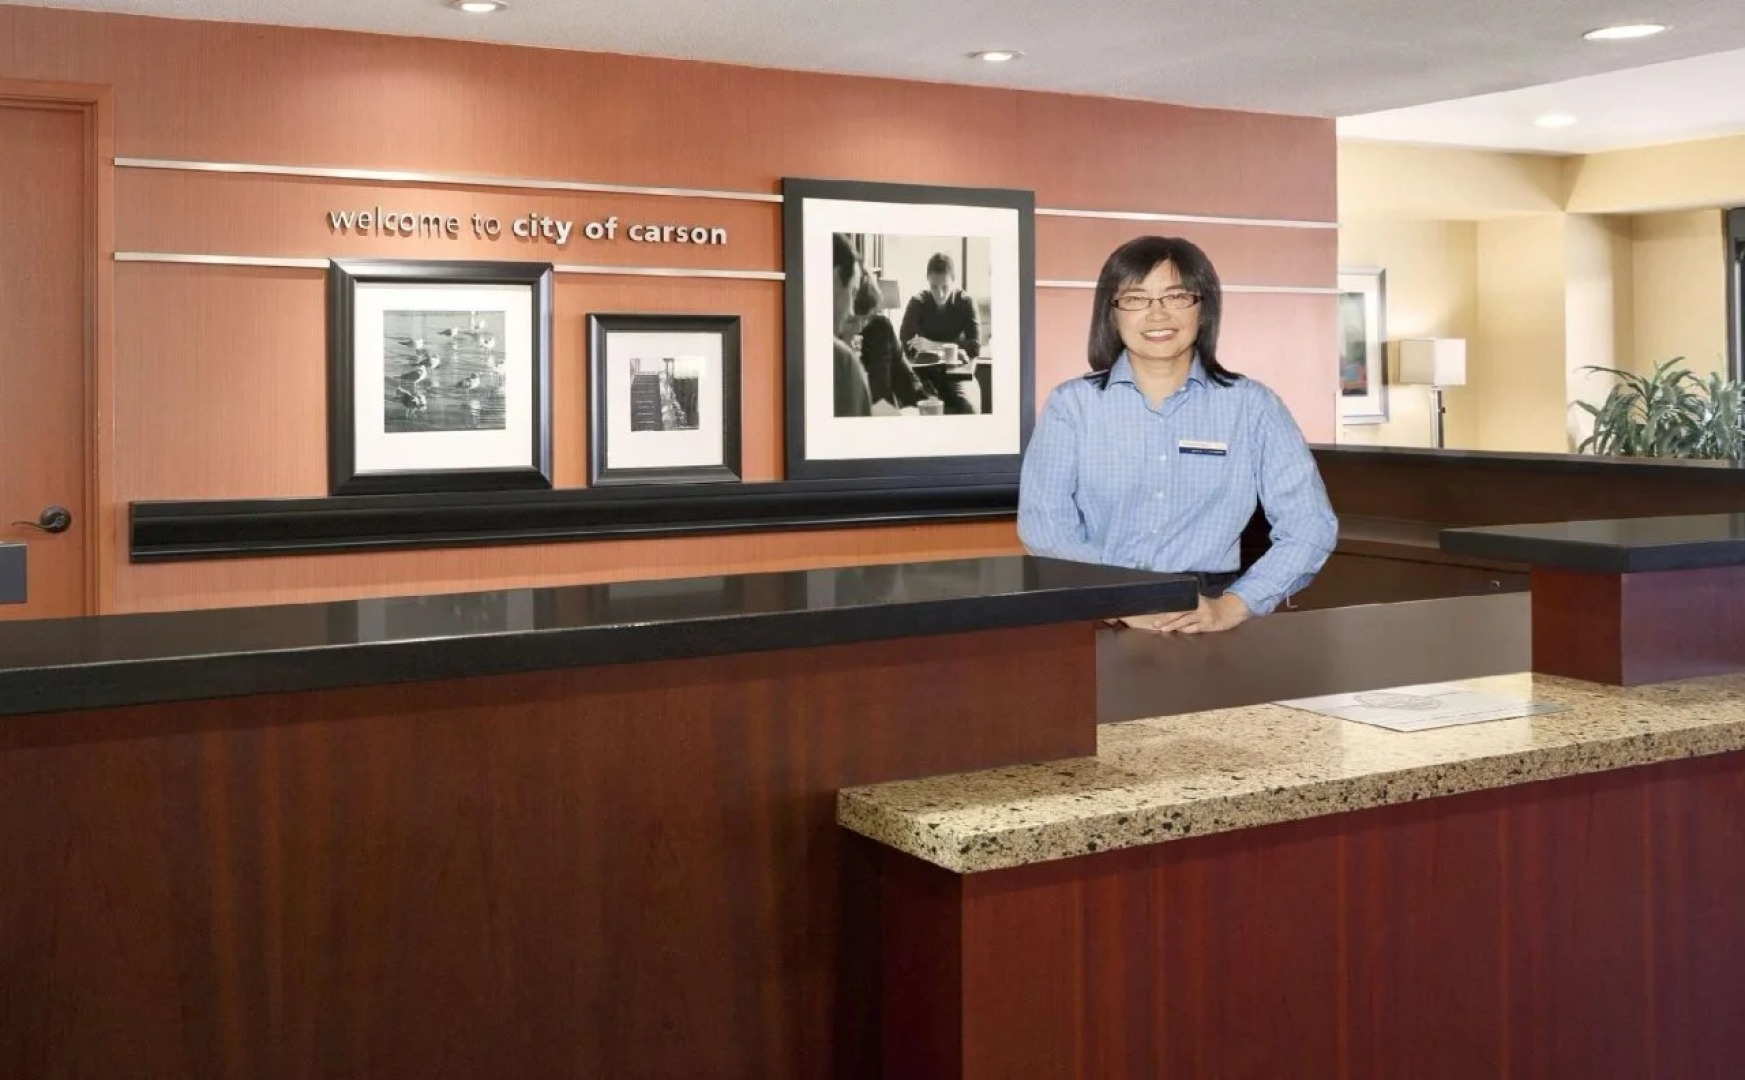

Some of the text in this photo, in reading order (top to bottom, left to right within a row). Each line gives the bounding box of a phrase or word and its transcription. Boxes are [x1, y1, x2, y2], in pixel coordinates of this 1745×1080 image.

[328, 206, 728, 245] welcome to city of carson
